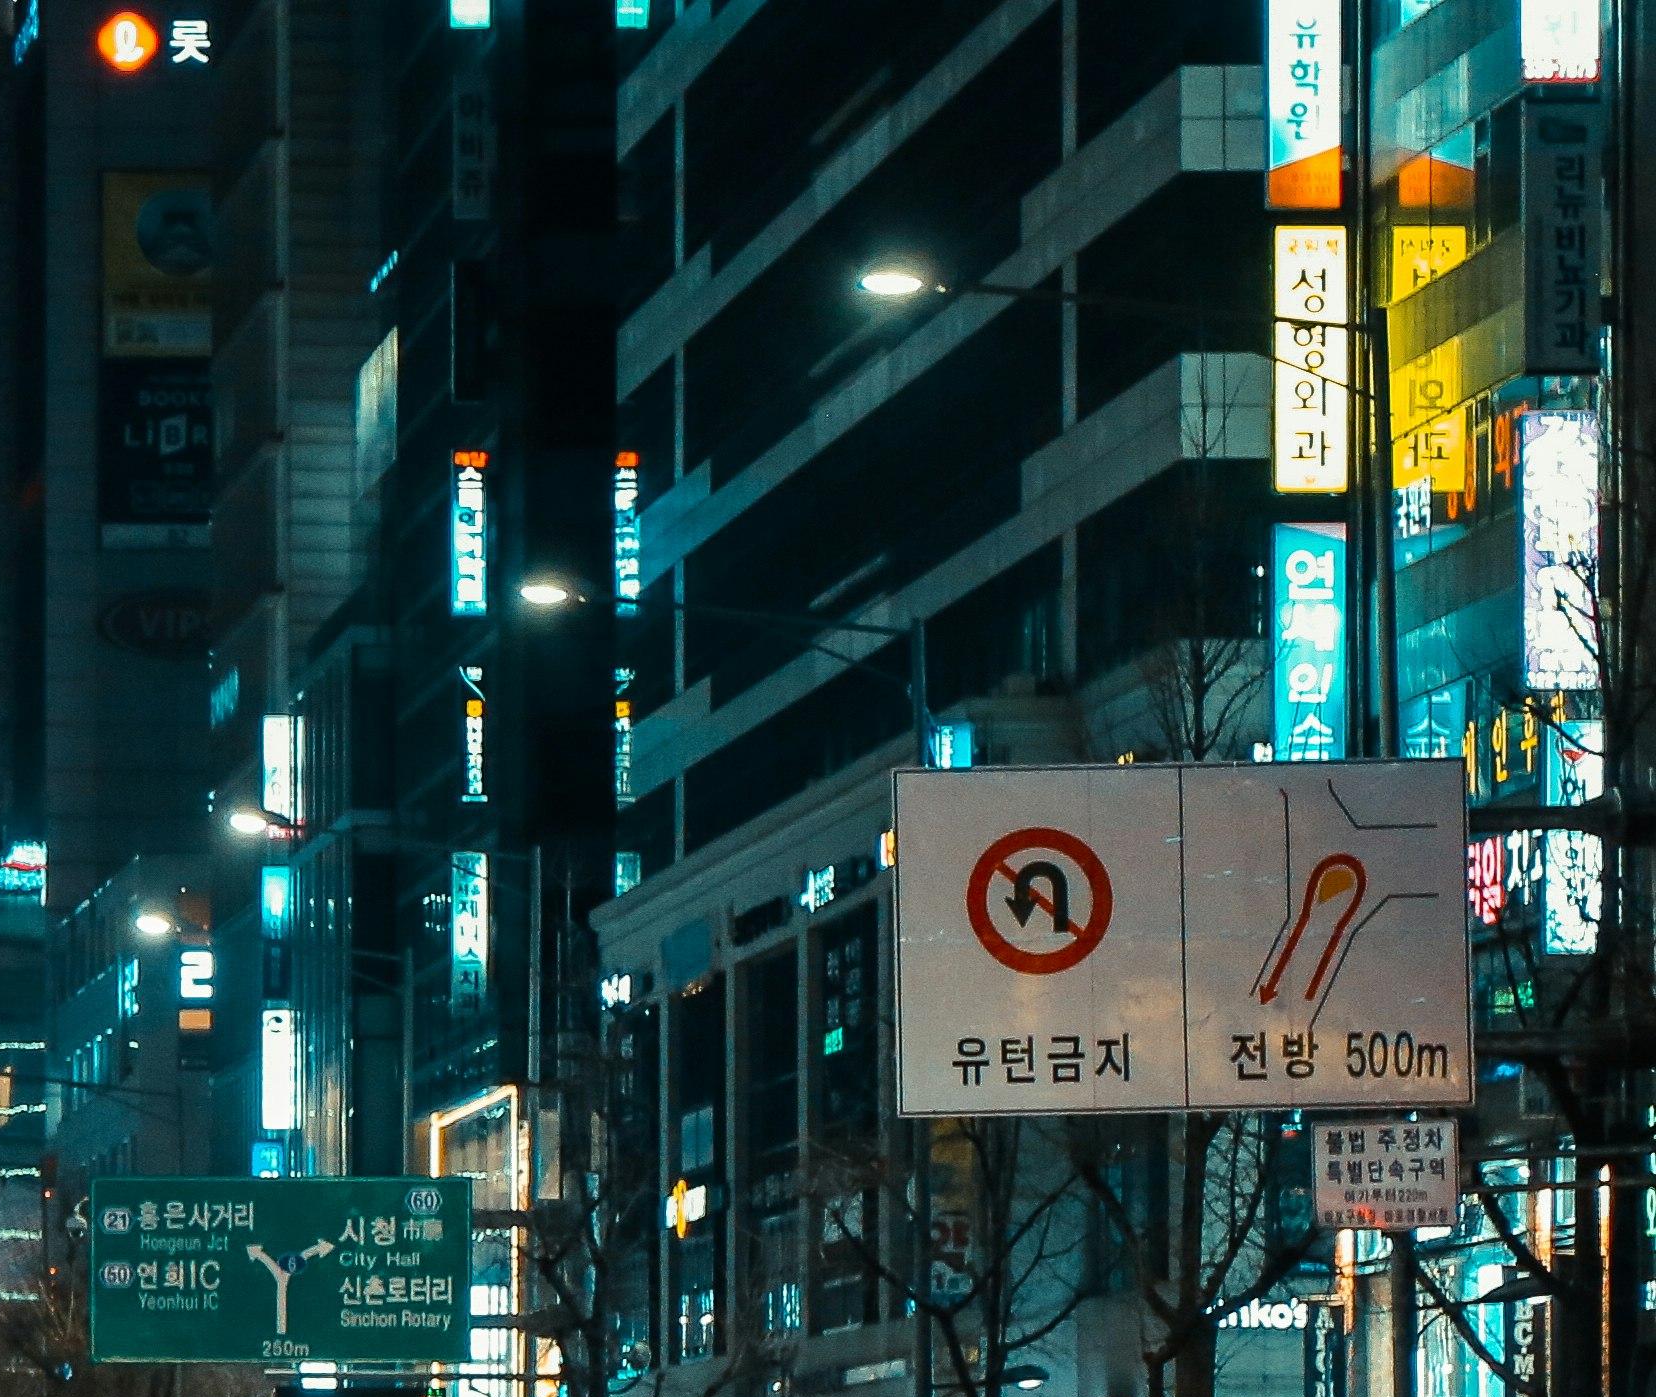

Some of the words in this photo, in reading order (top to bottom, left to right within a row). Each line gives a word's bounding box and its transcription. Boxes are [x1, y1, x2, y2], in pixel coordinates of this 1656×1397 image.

[169, 20, 211, 63] 롯
[1291, 267, 1331, 468] 성형외과
[952, 1032, 1130, 1087] 유턴금지
[1230, 1031, 1319, 1080] 전방
[1345, 1030, 1448, 1079] 500m
[1326, 1130, 1365, 1155] 불법
[1327, 1157, 1446, 1185] 특별단속구역
[108, 1213, 128, 1231] 21
[138, 1201, 255, 1232] 홍은사거리
[338, 1216, 396, 1246] 시청
[141, 1234, 202, 1255] Hongeun
[207, 1235, 229, 1252] Jct
[137, 1260, 221, 1291] 연희IC
[339, 1251, 377, 1271] City
[386, 1251, 421, 1267] Hall
[138, 1292, 198, 1311] Yeonhui
[203, 1292, 220, 1311] IC
[339, 1275, 453, 1306] 신촌로터리
[340, 1309, 398, 1328] Sinchon
[401, 1309, 452, 1332] Rotary
[262, 1340, 310, 1358] 250m
